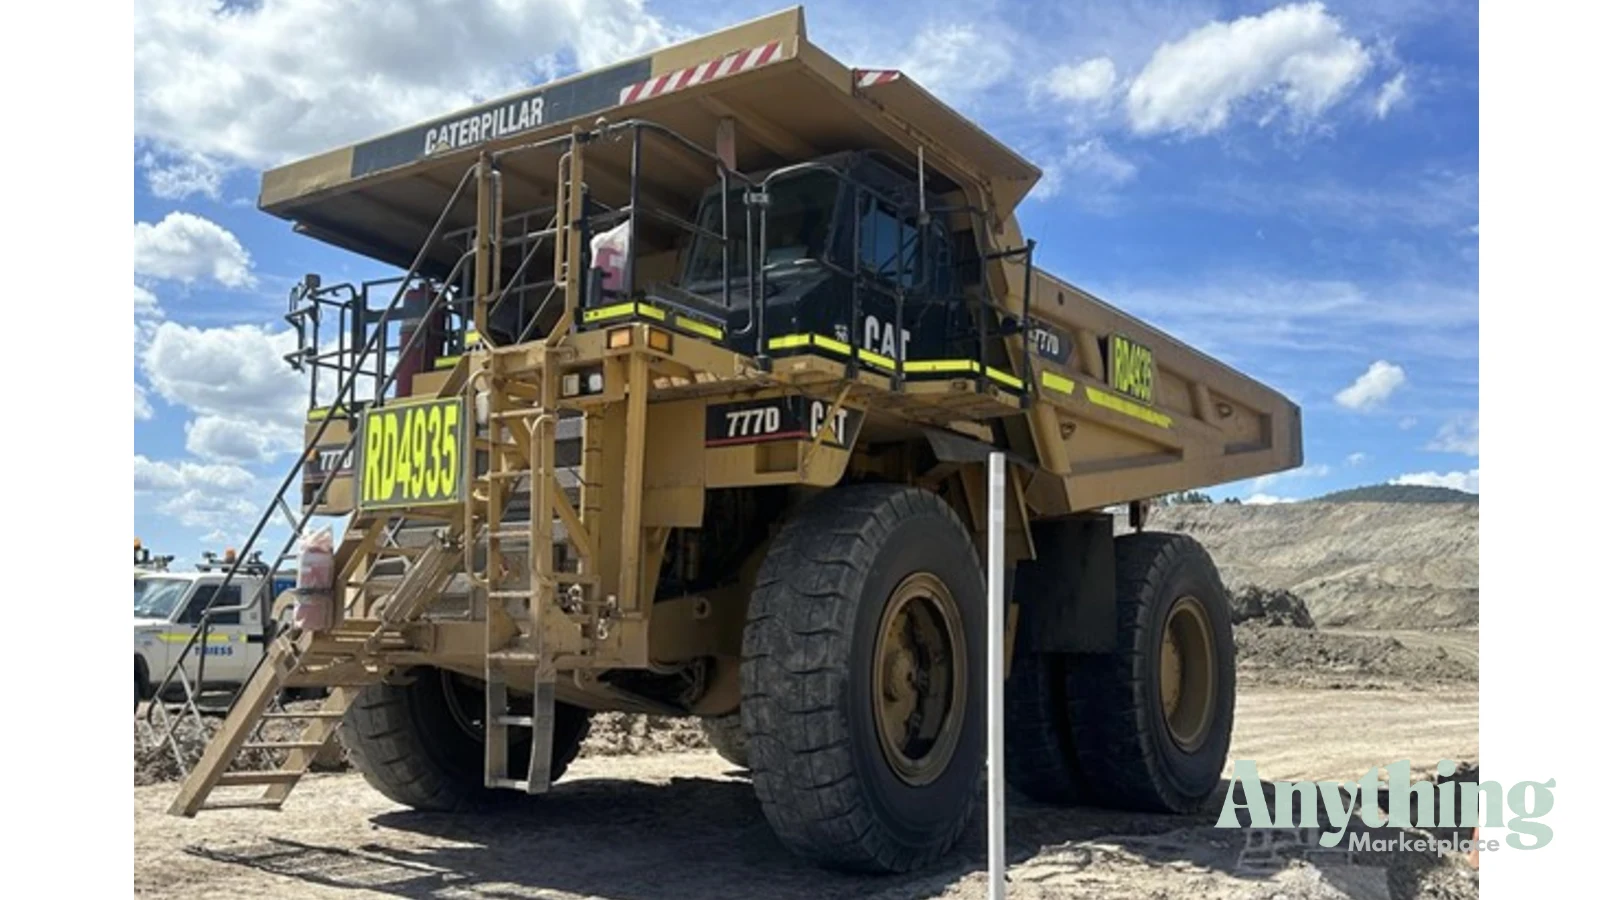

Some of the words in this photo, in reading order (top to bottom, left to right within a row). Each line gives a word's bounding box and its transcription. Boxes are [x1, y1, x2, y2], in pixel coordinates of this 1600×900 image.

[425, 97, 544, 155] CATERPILLAR
[864, 314, 911, 366] CAT
[726, 406, 780, 437] 777D
[363, 404, 458, 501] RD4935
